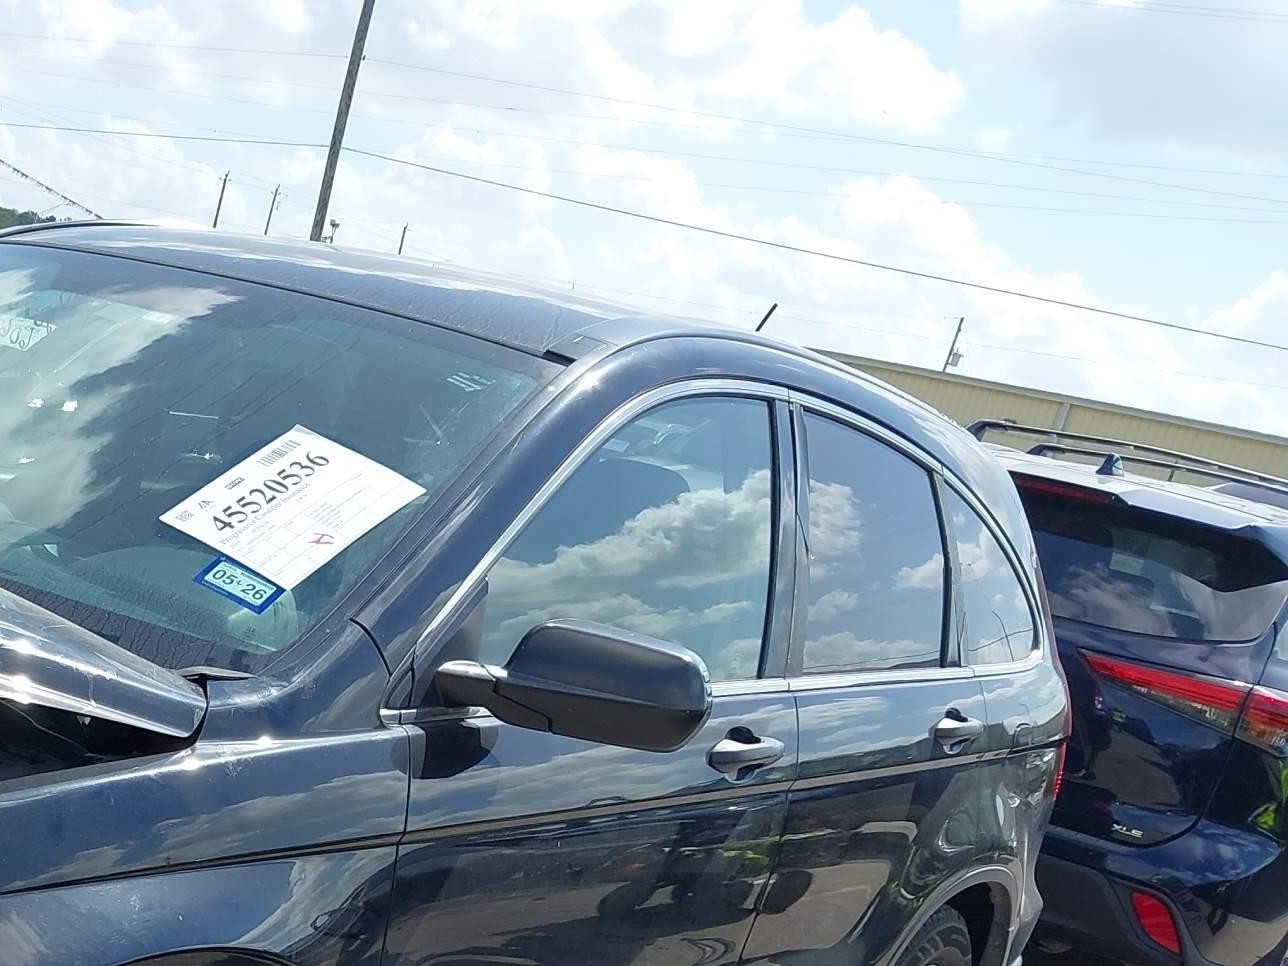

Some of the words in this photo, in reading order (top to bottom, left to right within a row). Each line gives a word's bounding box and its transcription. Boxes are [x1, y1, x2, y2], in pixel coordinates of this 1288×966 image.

[213, 451, 330, 531] 45520536
[212, 569, 238, 586] 05
[240, 583, 268, 600] 26
[1112, 823, 1144, 838] XLE
